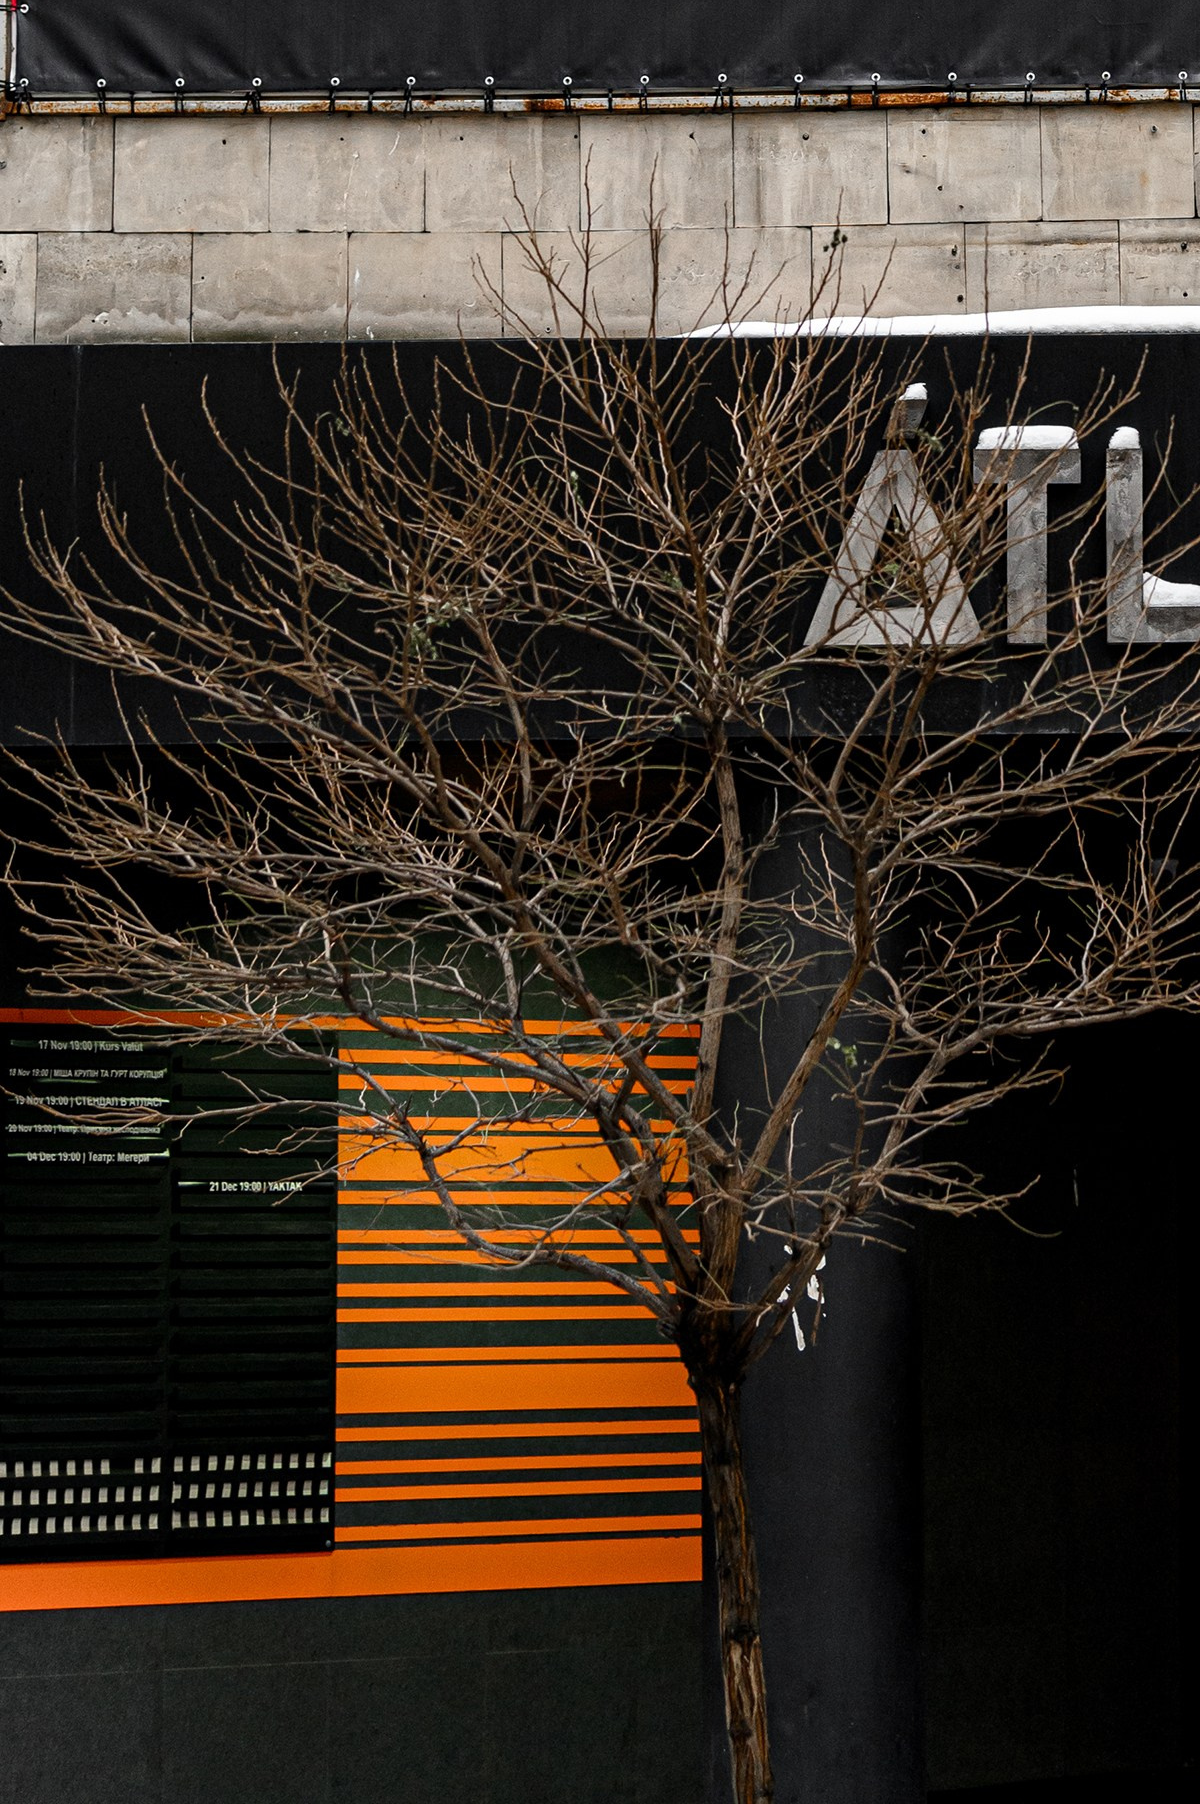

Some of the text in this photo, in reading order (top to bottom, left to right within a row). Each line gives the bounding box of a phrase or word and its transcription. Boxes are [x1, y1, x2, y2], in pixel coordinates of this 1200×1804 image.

[38, 1039, 49, 1050] 17
[51, 1040, 68, 1051] Nov
[71, 1040, 93, 1051] 19:00
[100, 1041, 120, 1052] Kurs
[18, 1068, 31, 1076] Nov
[32, 1068, 49, 1077] 19:00
[15, 1096, 26, 1106] 19
[46, 1096, 69, 1106] 19:00
[26, 1151, 38, 1162] 04
[39, 1151, 57, 1162] Dec
[58, 1151, 81, 1162] 19:00
[209, 1181, 219, 1192] 21
[221, 1181, 237, 1192] Dec
[239, 1181, 261, 1193] 19:00
